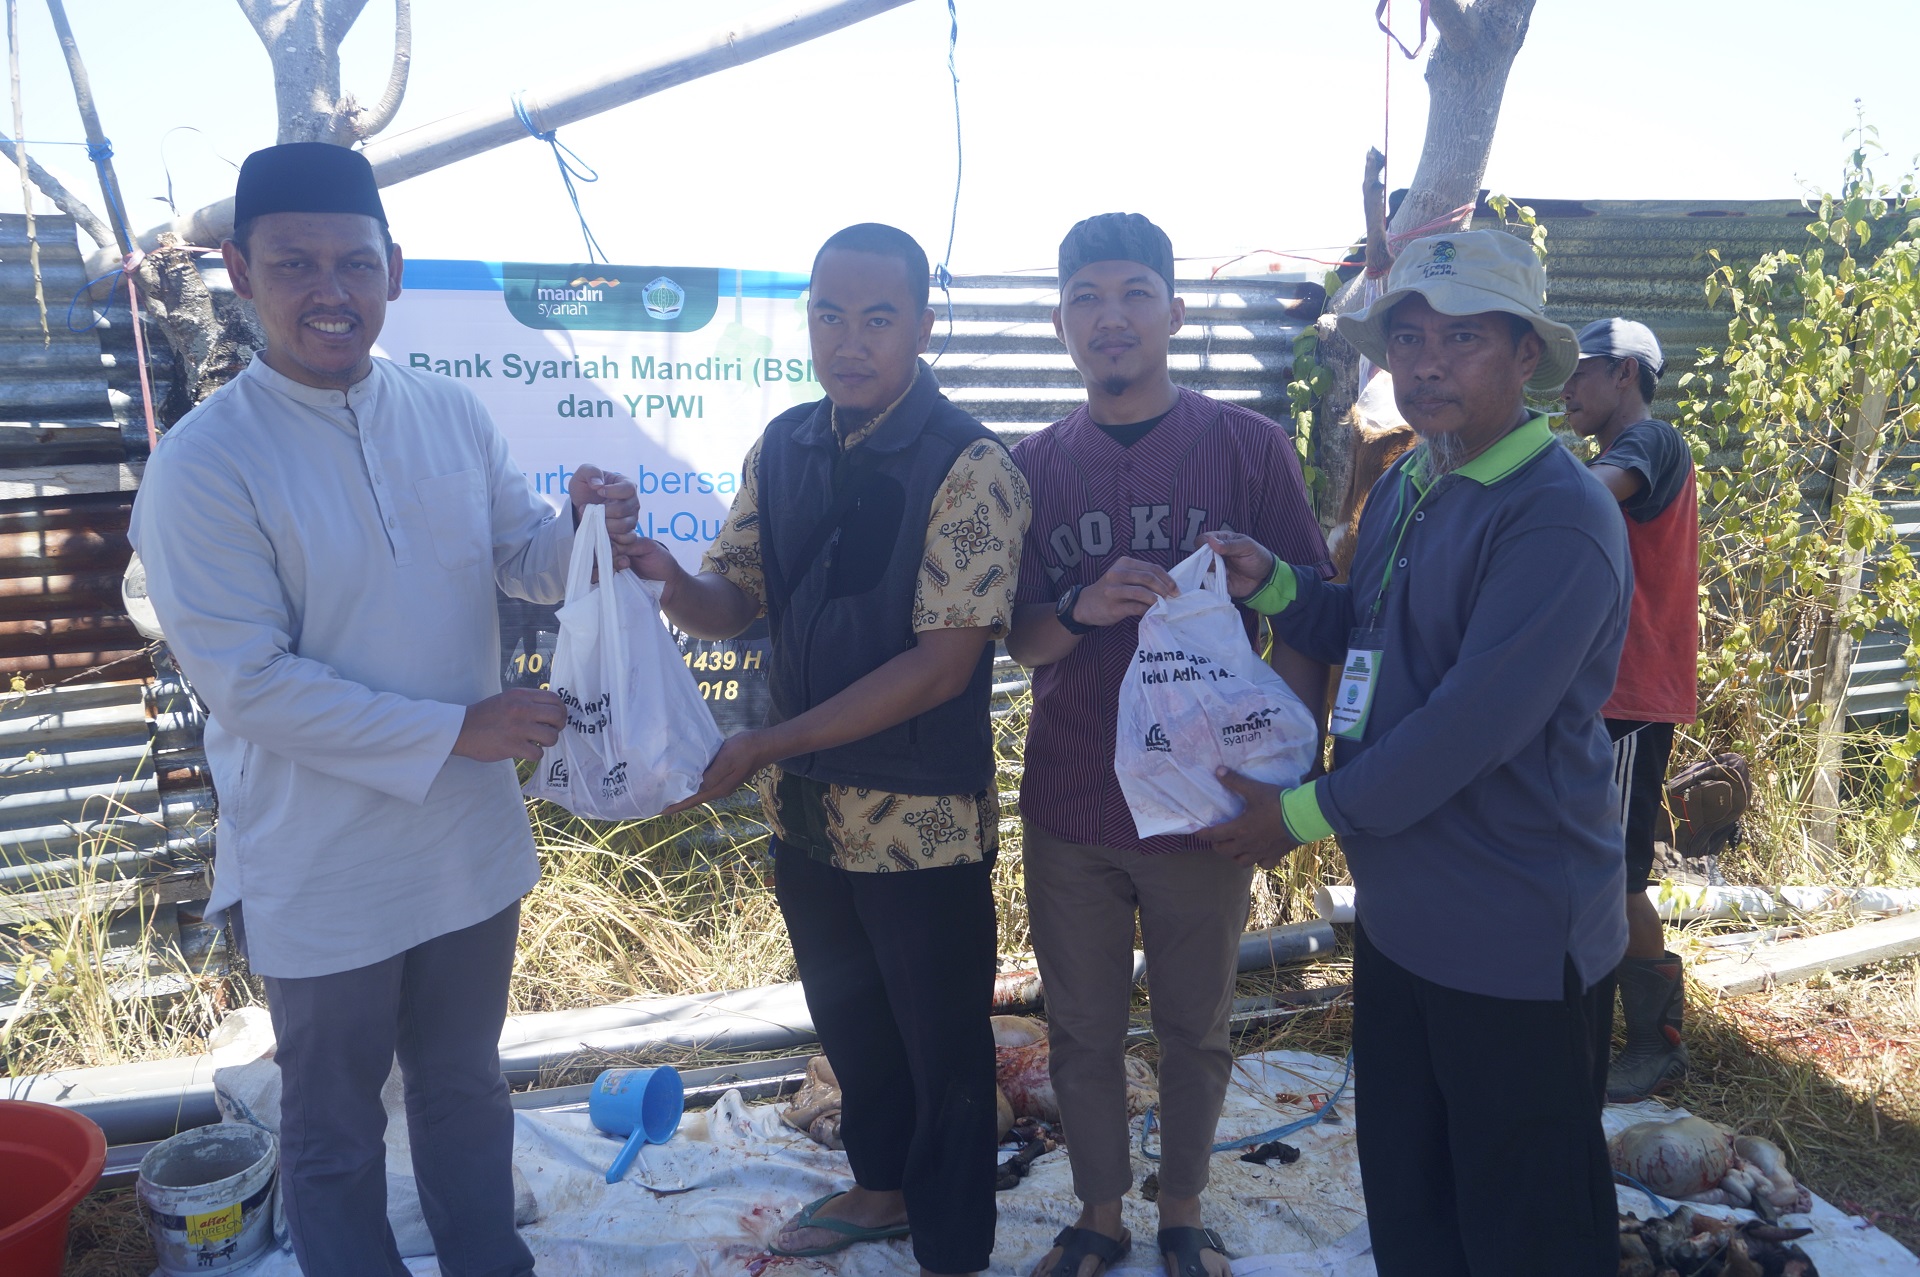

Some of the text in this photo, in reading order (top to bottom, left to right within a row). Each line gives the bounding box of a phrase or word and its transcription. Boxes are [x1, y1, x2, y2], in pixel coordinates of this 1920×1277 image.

[537, 285, 603, 302] mandiri
[537, 302, 588, 318] syariah
[409, 352, 493, 378] Bank
[502, 353, 619, 385] Syariah
[631, 355, 742, 381] Mandiri
[557, 393, 703, 418] dan YPWI
[639, 464, 743, 494] bersa
[514, 653, 543, 673] 10
[682, 650, 737, 671] 1439
[743, 650, 763, 670] H
[1172, 665, 1206, 682] Adh
[697, 679, 739, 700] 018
